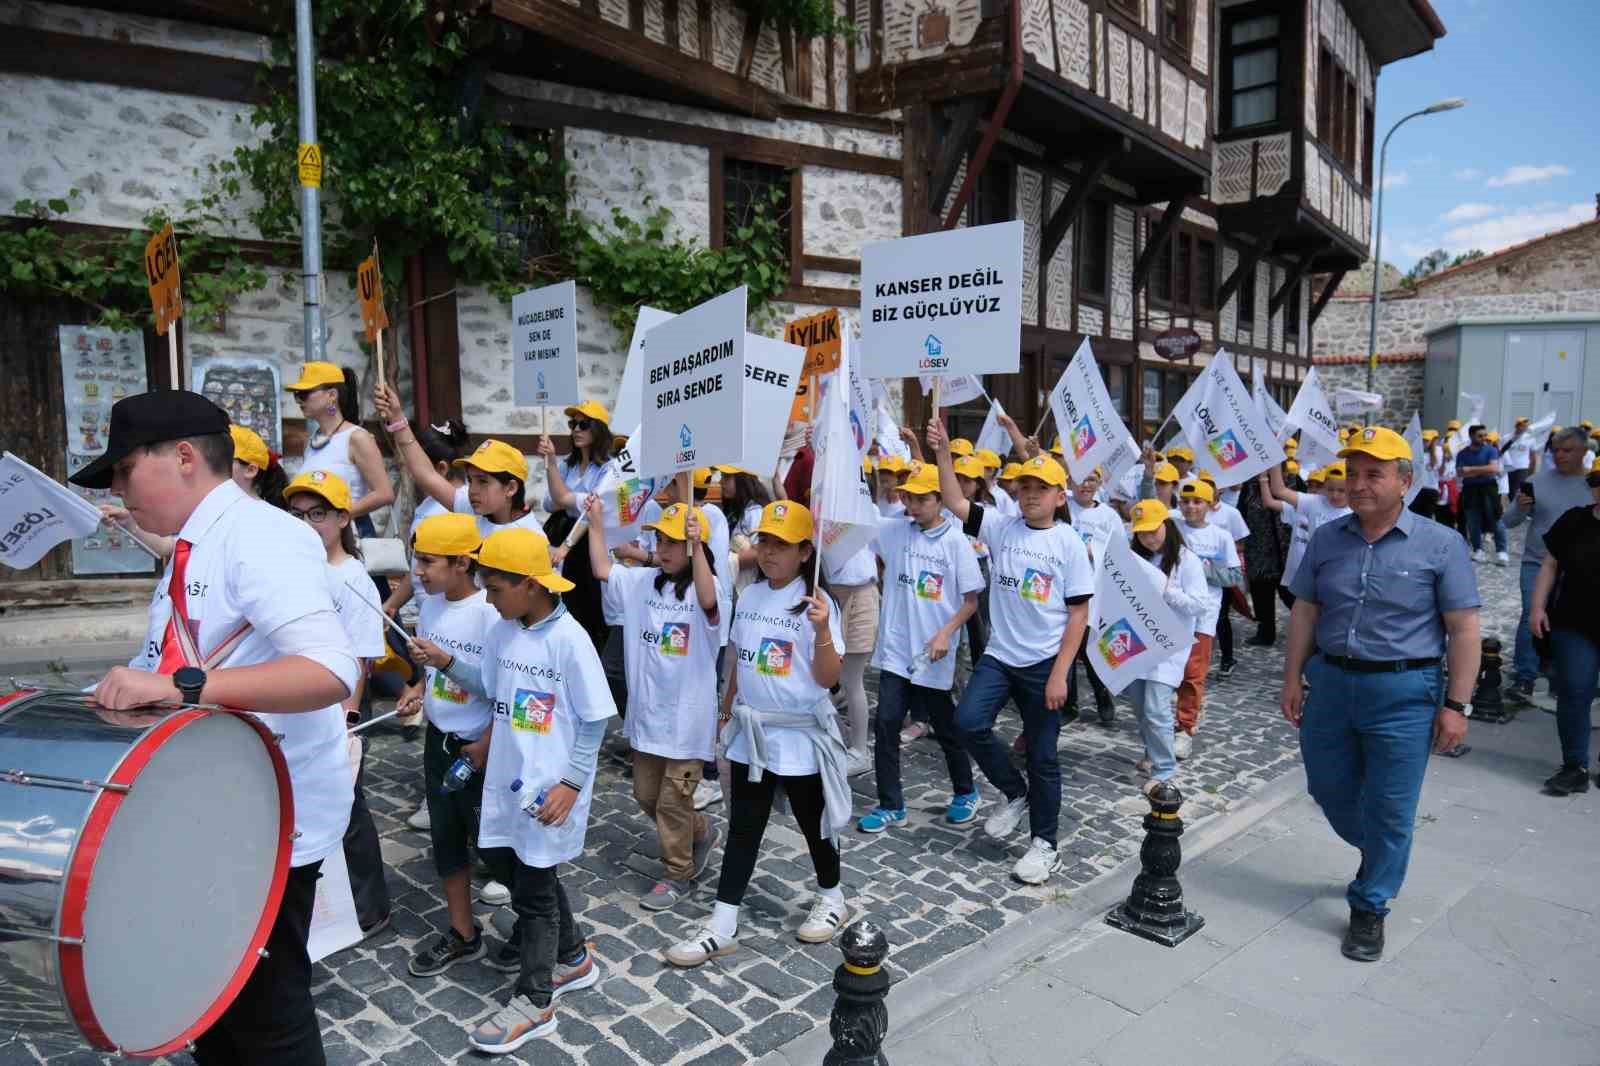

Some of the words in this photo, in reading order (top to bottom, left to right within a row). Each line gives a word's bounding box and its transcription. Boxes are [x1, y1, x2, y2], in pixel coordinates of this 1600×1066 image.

[875, 277, 942, 298] KANSER
[948, 267, 1003, 290] DEĞİL
[872, 305, 898, 322] BİZ
[903, 295, 1000, 321] GÜÇLÜYÜZ
[528, 331, 541, 343] SEN
[542, 328, 551, 340] DE
[790, 315, 837, 347] İYİLİK
[650, 364, 671, 384] BEN
[673, 339, 734, 375] BAŞARDIM
[919, 358, 950, 369] LÖSEV
[657, 388, 681, 409] SIRA
[684, 374, 723, 401] SENDE
